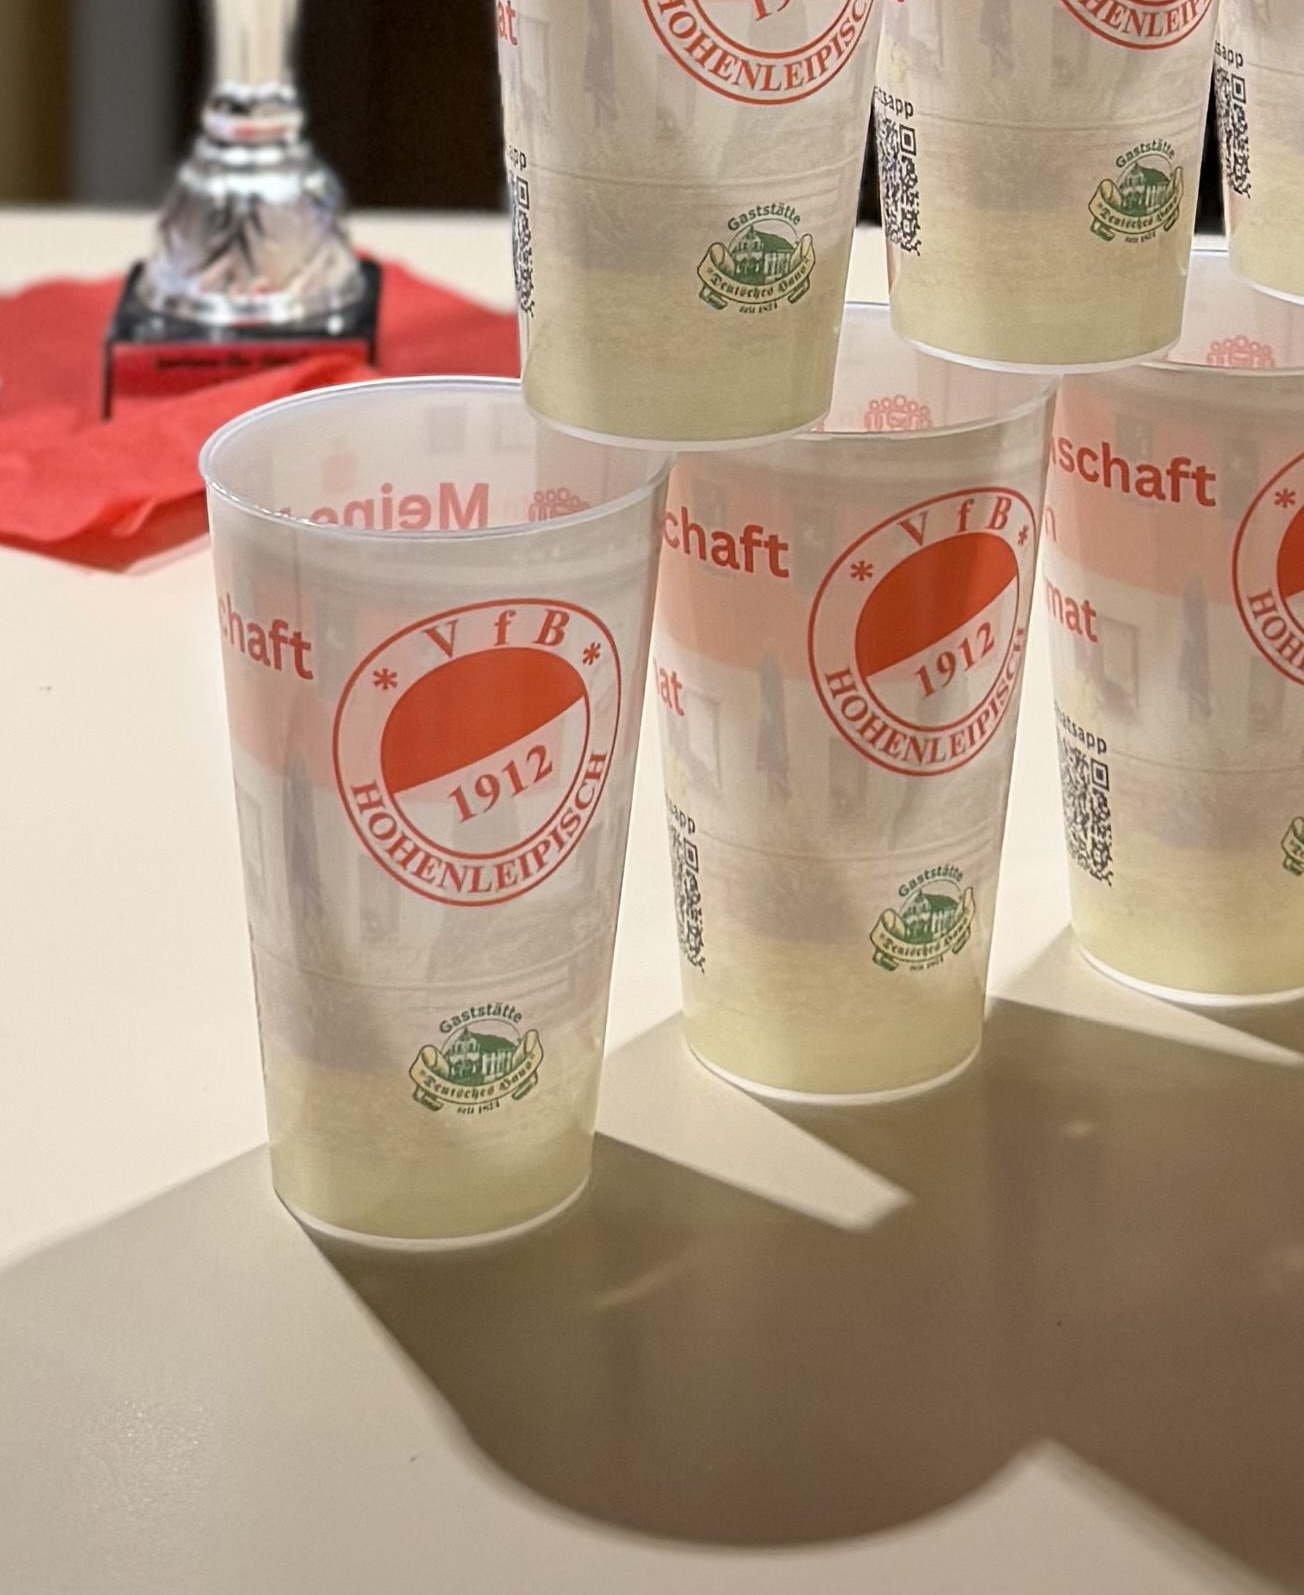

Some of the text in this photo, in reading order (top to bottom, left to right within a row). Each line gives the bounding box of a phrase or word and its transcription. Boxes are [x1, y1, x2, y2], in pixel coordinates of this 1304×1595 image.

[727, 201, 801, 231] Gaststätte
[914, 621, 995, 698] 1912
[350, 750, 608, 894] HOHENLEIPISCH
[448, 744, 554, 824] 1912
[439, 1002, 522, 1034] Gaststätte
